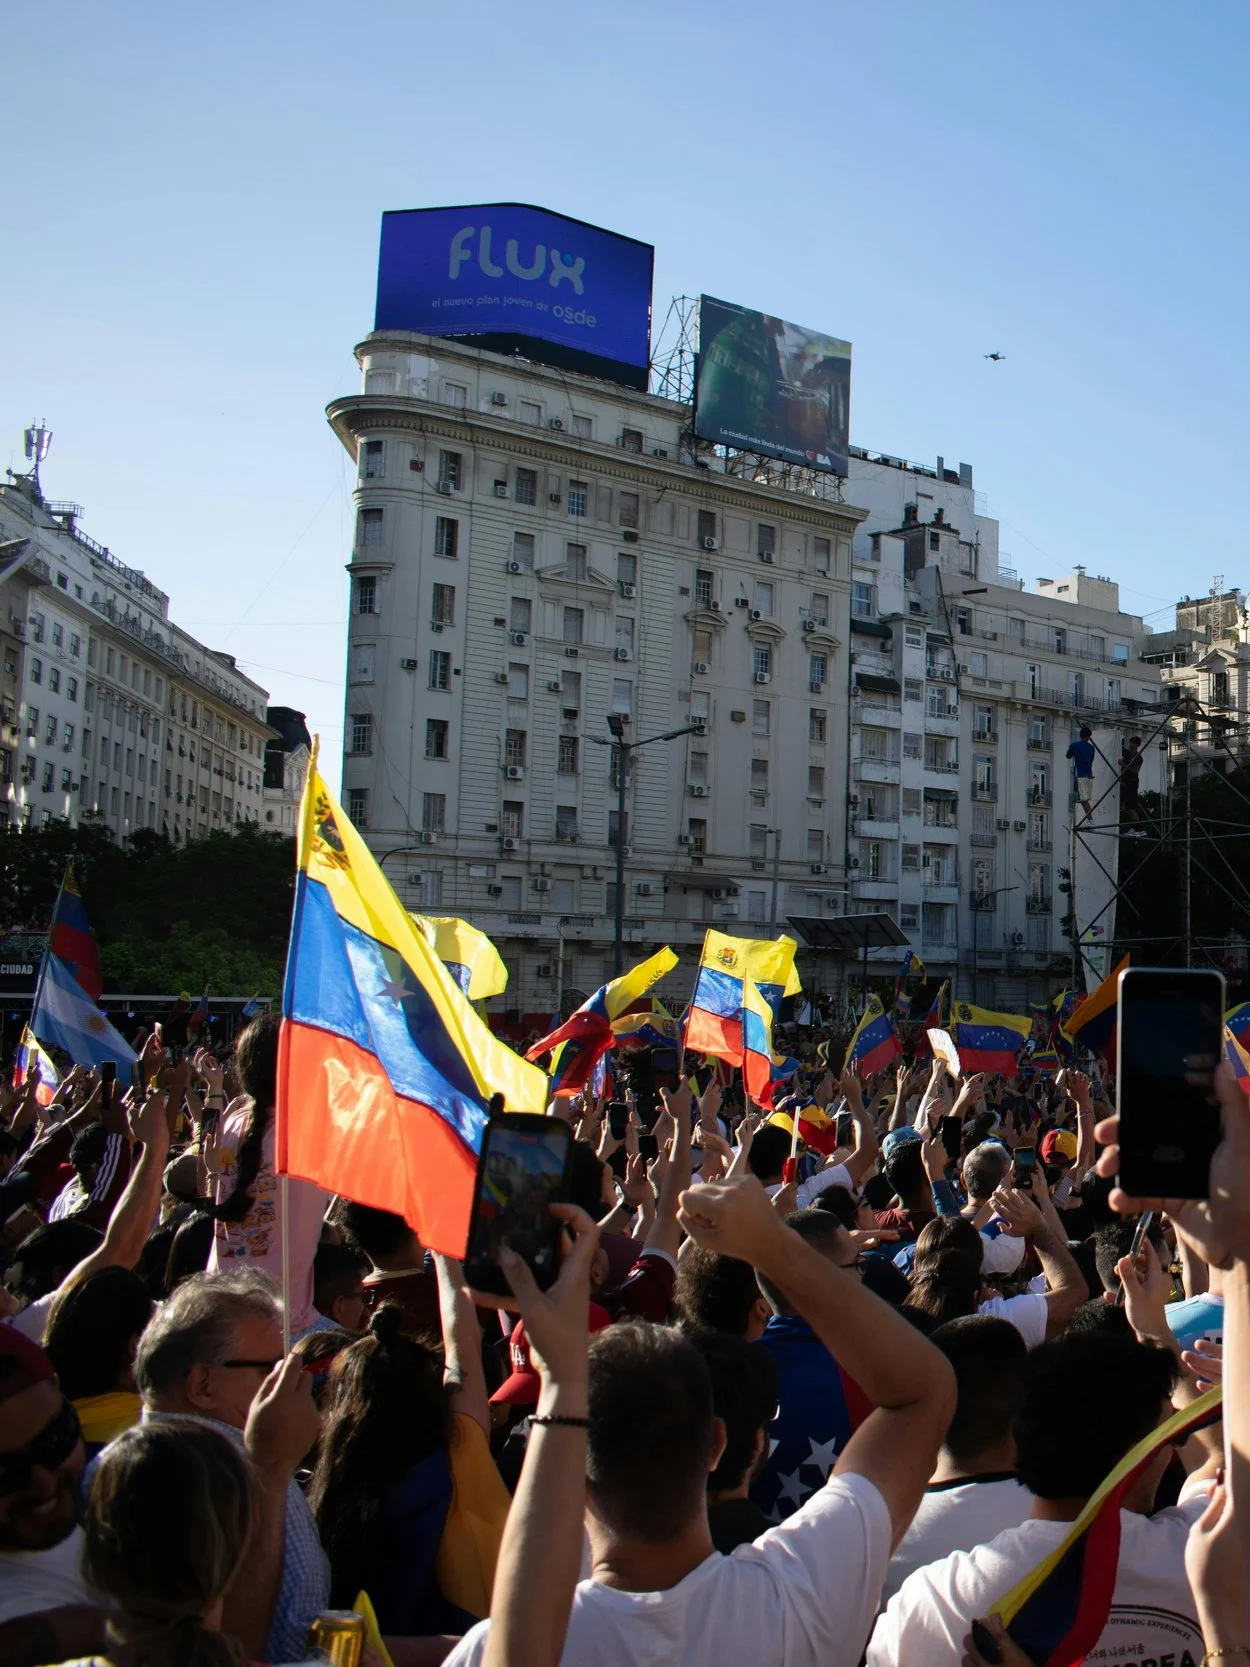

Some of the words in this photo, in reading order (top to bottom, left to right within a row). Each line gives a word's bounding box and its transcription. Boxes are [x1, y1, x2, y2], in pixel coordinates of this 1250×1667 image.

[431, 298, 441, 308] el
[443, 298, 474, 307] nuevo
[476, 295, 500, 307] plan
[503, 295, 533, 307] joven
[536, 302, 549, 312] de
[552, 305, 597, 328] osde
[719, 427, 728, 435] La
[729, 430, 748, 440] ciudad
[748, 436, 761, 445] más
[761, 439, 775, 449] linda
[776, 443, 785, 451] del
[785, 447, 805, 457] mundo
[0, 963, 33, 974] CIUDAD
[1110, 1618, 1146, 1626] DYNAMIC
[1146, 1619, 1192, 1641] EXPERIENCES
